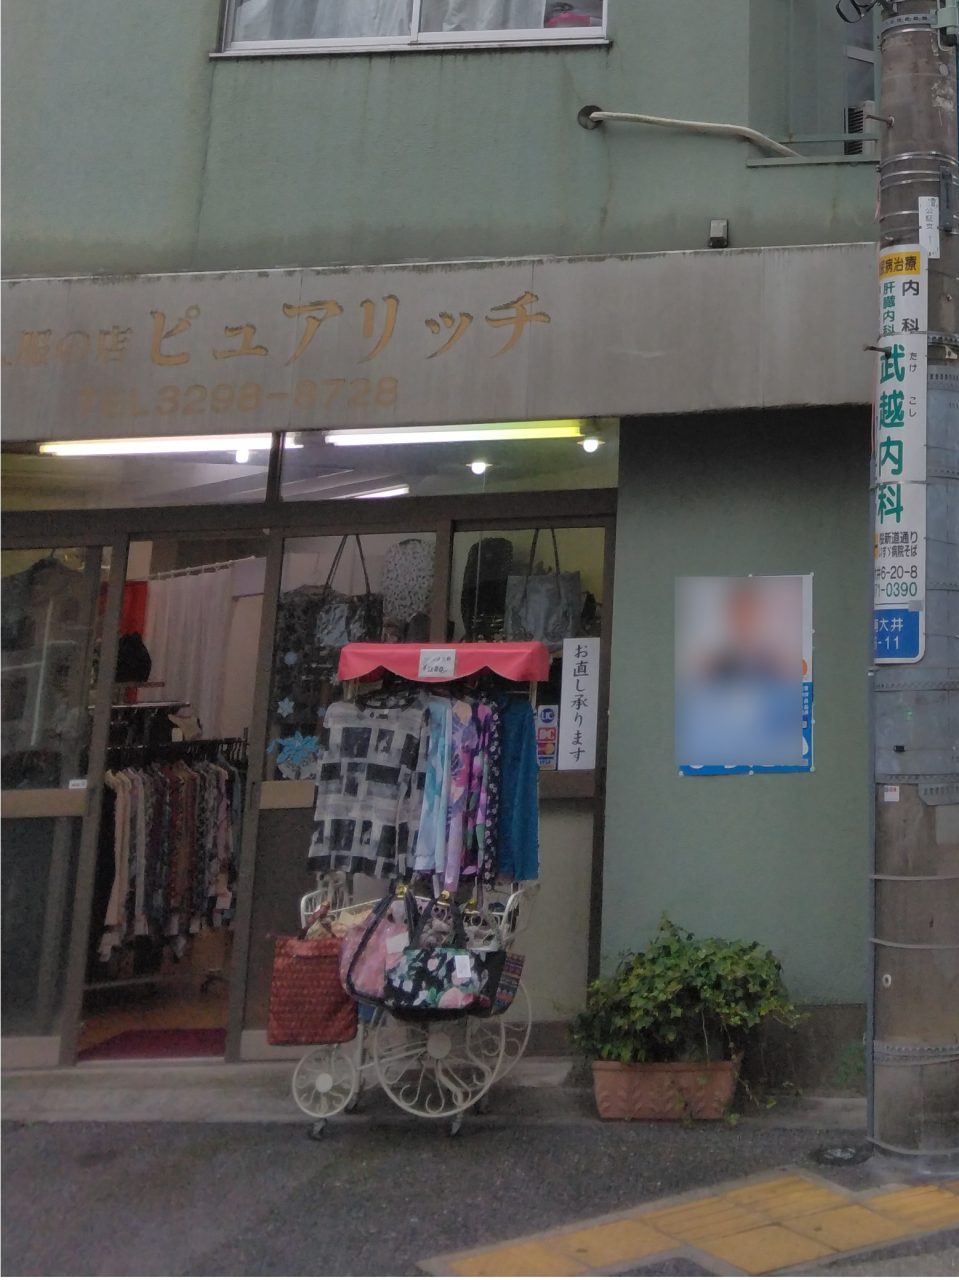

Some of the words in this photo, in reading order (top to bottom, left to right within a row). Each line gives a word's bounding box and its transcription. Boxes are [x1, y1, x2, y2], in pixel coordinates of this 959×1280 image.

[150, 290, 551, 366] ピュアリッチ
[878, 343, 906, 525] 武越内科
[569, 644, 589, 762] お直し承ります
